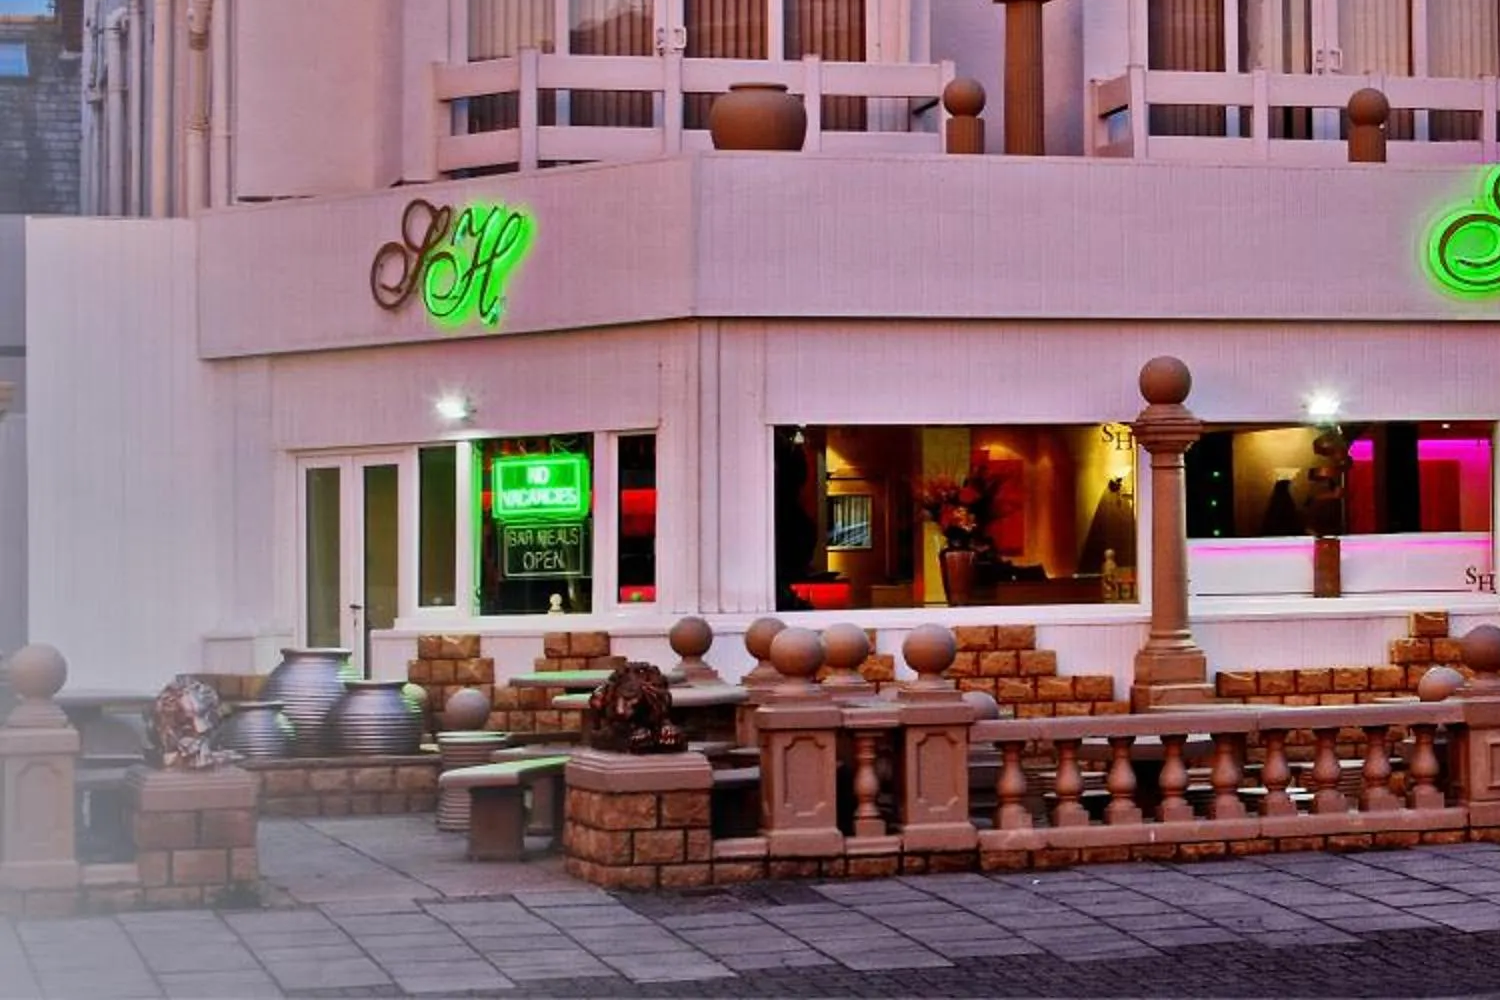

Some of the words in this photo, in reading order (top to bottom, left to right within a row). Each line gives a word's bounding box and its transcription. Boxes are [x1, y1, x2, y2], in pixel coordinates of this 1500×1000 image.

[527, 466, 550, 485] NO
[508, 530, 533, 547] BAR
[538, 527, 579, 548] MEALS
[523, 550, 566, 570] OPEN
[1465, 566, 1496, 593] SH
